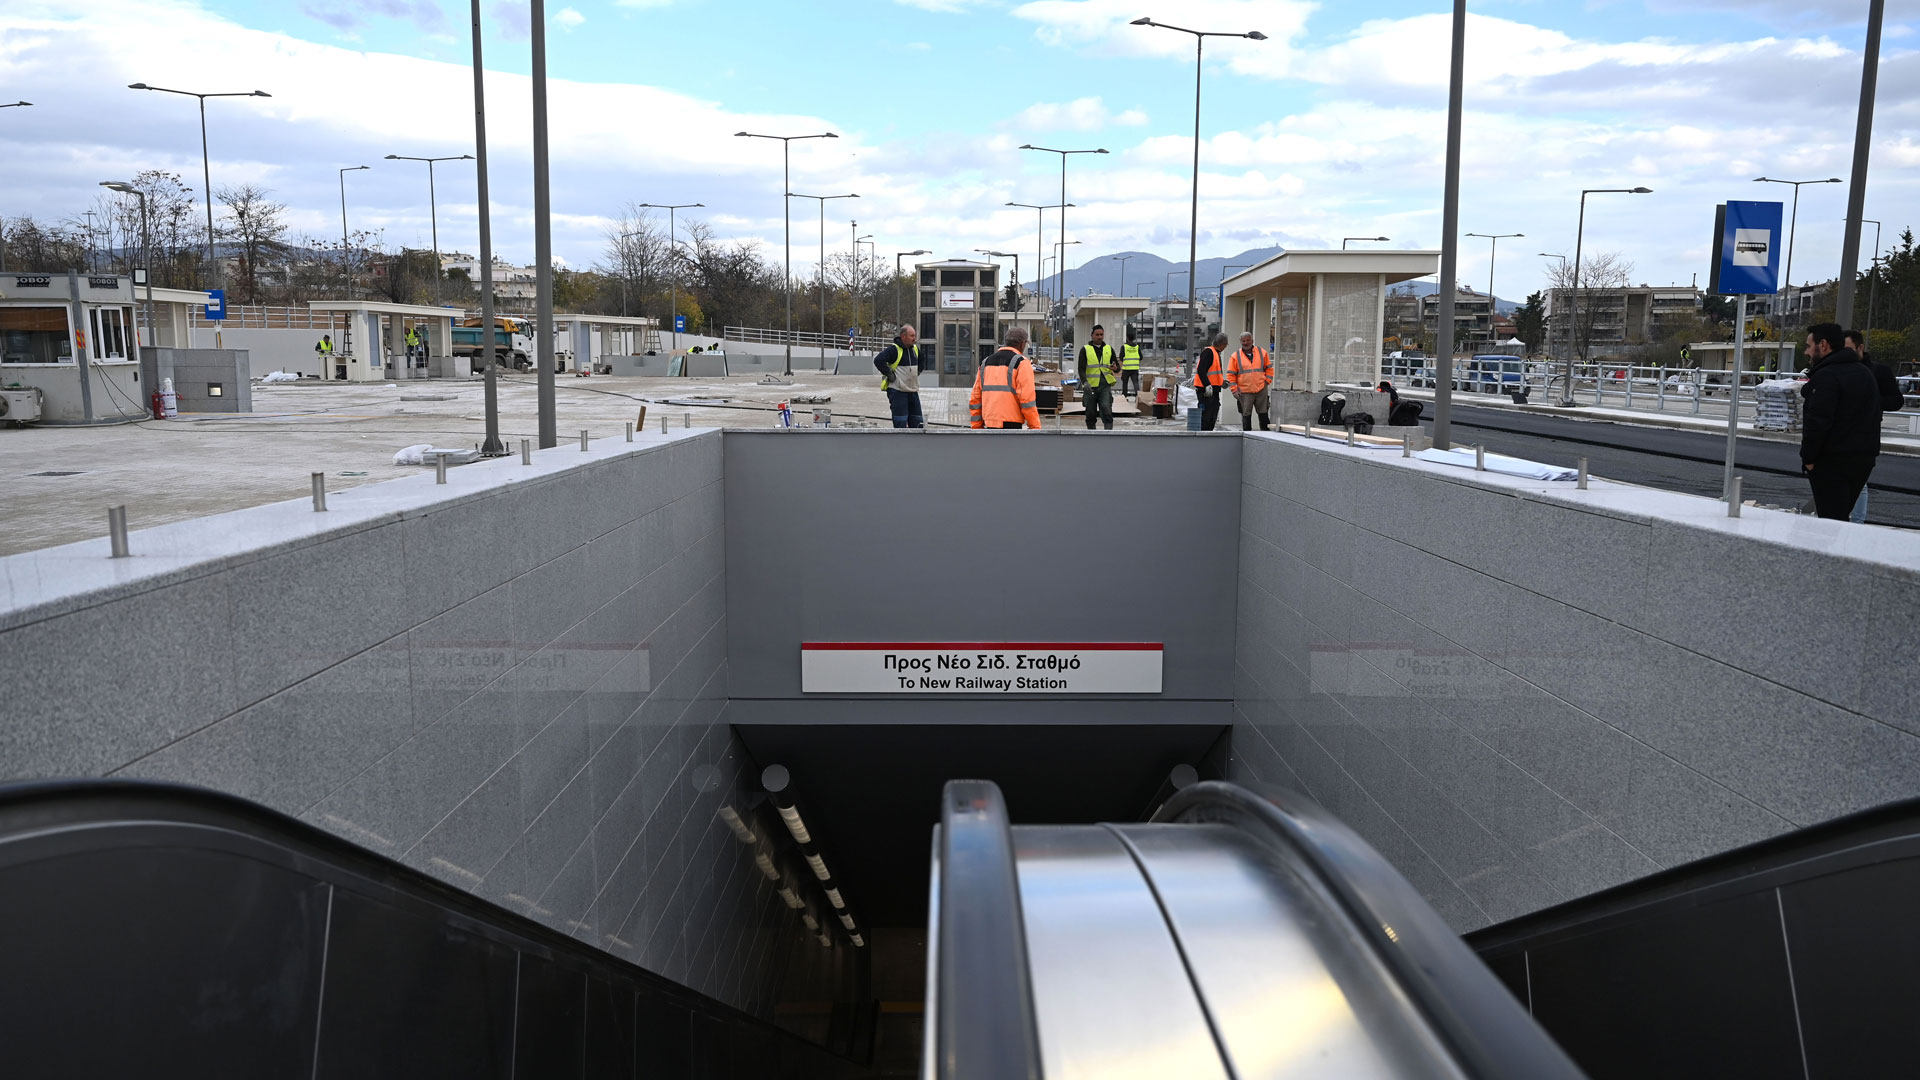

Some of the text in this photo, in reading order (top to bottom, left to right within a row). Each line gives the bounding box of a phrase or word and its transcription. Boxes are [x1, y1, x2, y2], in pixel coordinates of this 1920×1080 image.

[884, 654, 1081, 674] Προς Νέο Σιδ. Σταθμό
[897, 676, 1068, 691] To New Railway Station
